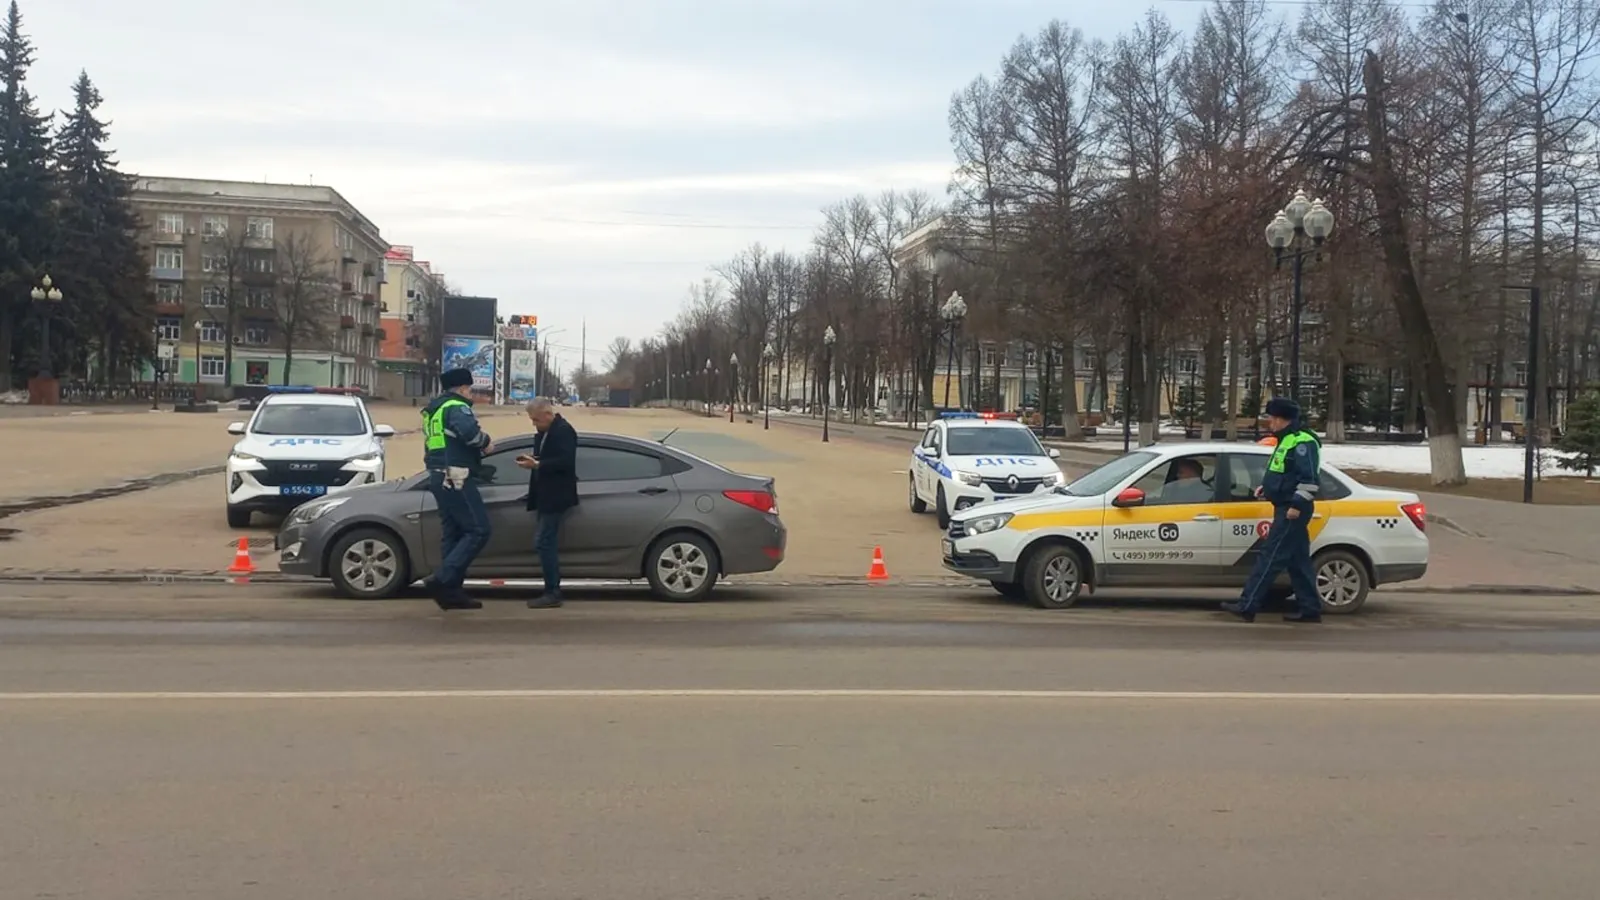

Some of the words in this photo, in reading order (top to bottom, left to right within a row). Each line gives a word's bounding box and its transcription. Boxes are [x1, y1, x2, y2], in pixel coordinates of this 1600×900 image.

[269, 438, 342, 446] ДПС
[975, 457, 1037, 467] ДПС
[1113, 528, 1156, 541] Яндекс
[1160, 526, 1178, 539] Go
[1232, 524, 1255, 536] 887
[1122, 551, 1147, 560] (495)
[1148, 550, 1194, 560] 999-99-99
